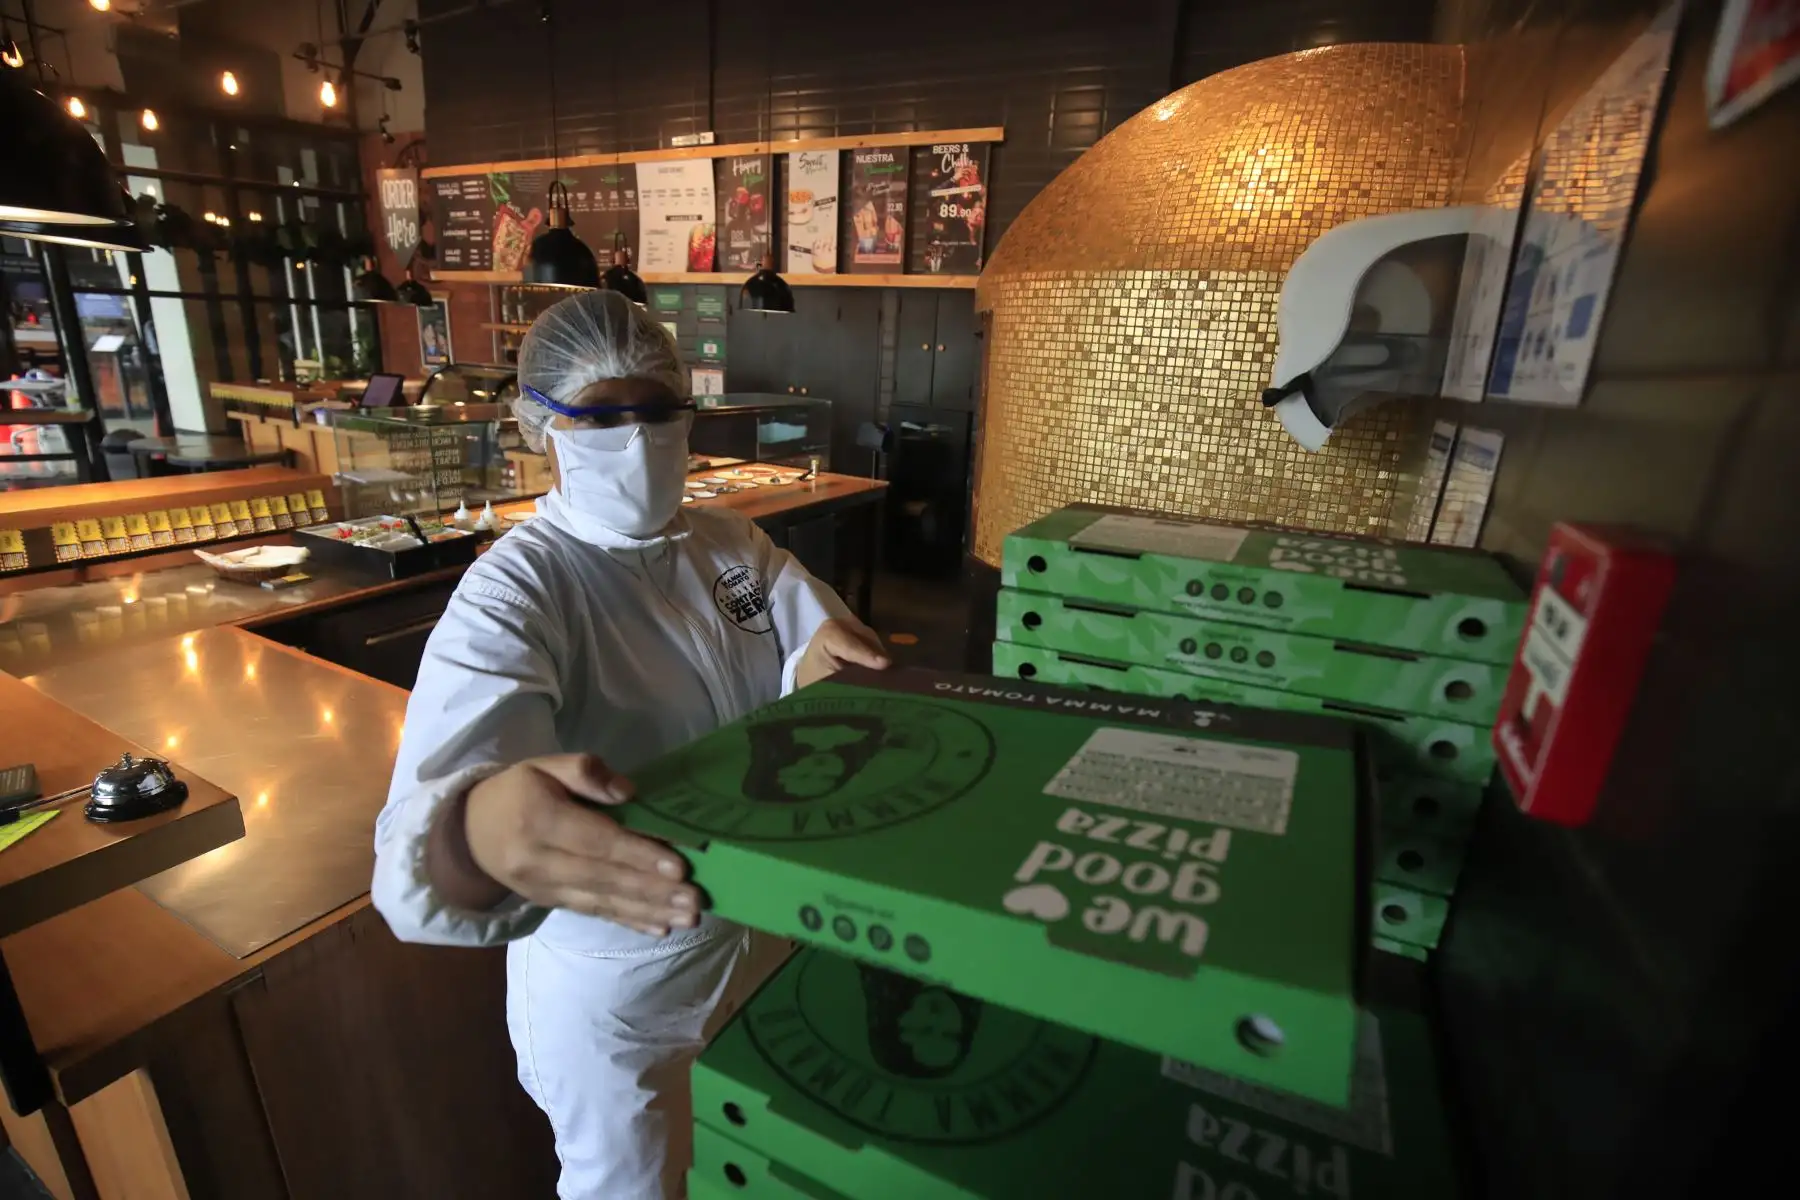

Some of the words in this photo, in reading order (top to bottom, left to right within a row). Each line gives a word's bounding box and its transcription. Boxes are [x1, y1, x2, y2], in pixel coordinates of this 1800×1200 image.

[856, 153, 894, 163] NUESTRA
[933, 145, 960, 154] BEERS
[962, 144, 969, 153] &
[382, 179, 416, 209] ORDER
[940, 204, 972, 218] 89.90
[386, 212, 417, 250] Here
[725, 586, 762, 610] CONTAC
[729, 597, 766, 623] ZER
[934, 681, 1037, 703] TOMATO
[1045, 696, 1161, 718] MAMMA
[1056, 807, 1232, 863] pizza
[1014, 840, 1221, 905] good
[1082, 896, 1210, 957] we
